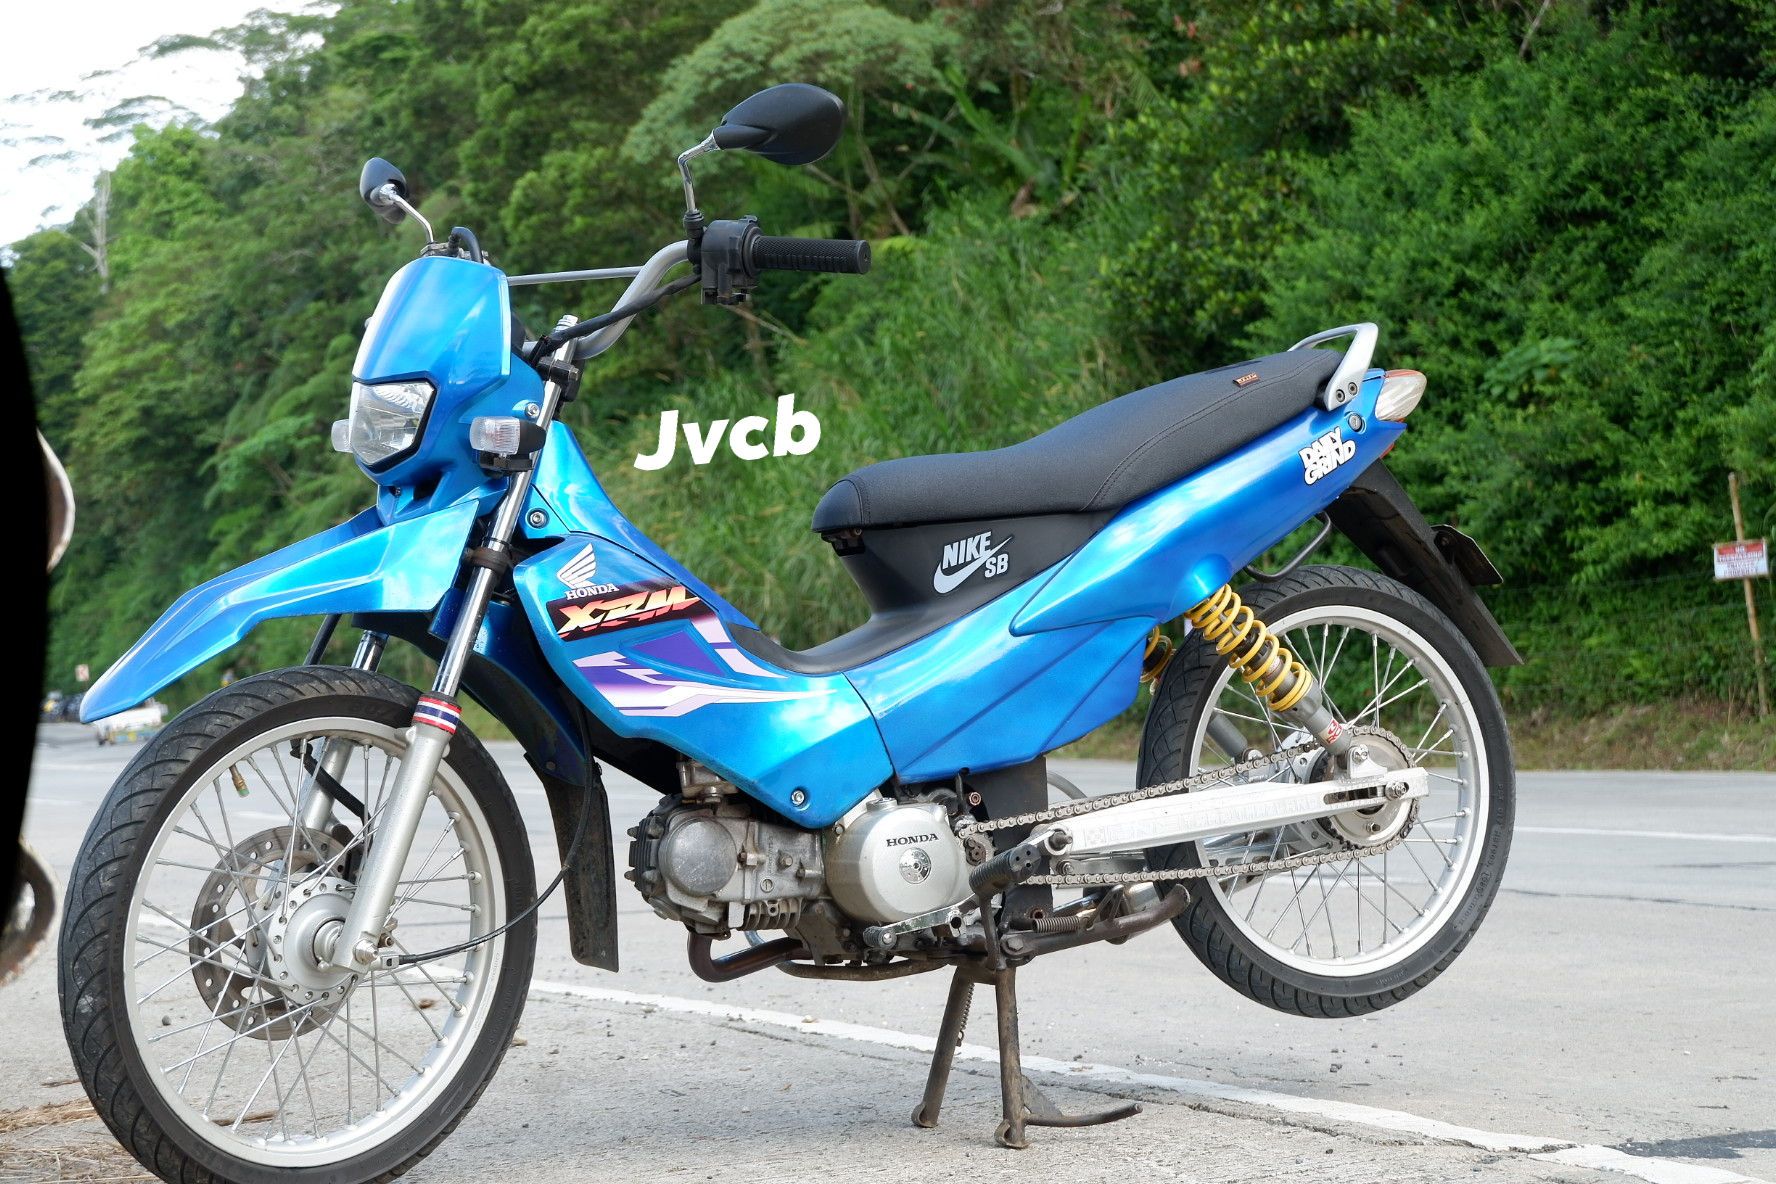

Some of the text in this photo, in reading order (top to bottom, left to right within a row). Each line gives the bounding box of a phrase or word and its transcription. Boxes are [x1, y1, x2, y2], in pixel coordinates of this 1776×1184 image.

[942, 531, 1009, 578] NIKE SB
[566, 583, 620, 601] HONDA
[557, 585, 700, 639] XRM
[886, 833, 939, 848] HONDA
